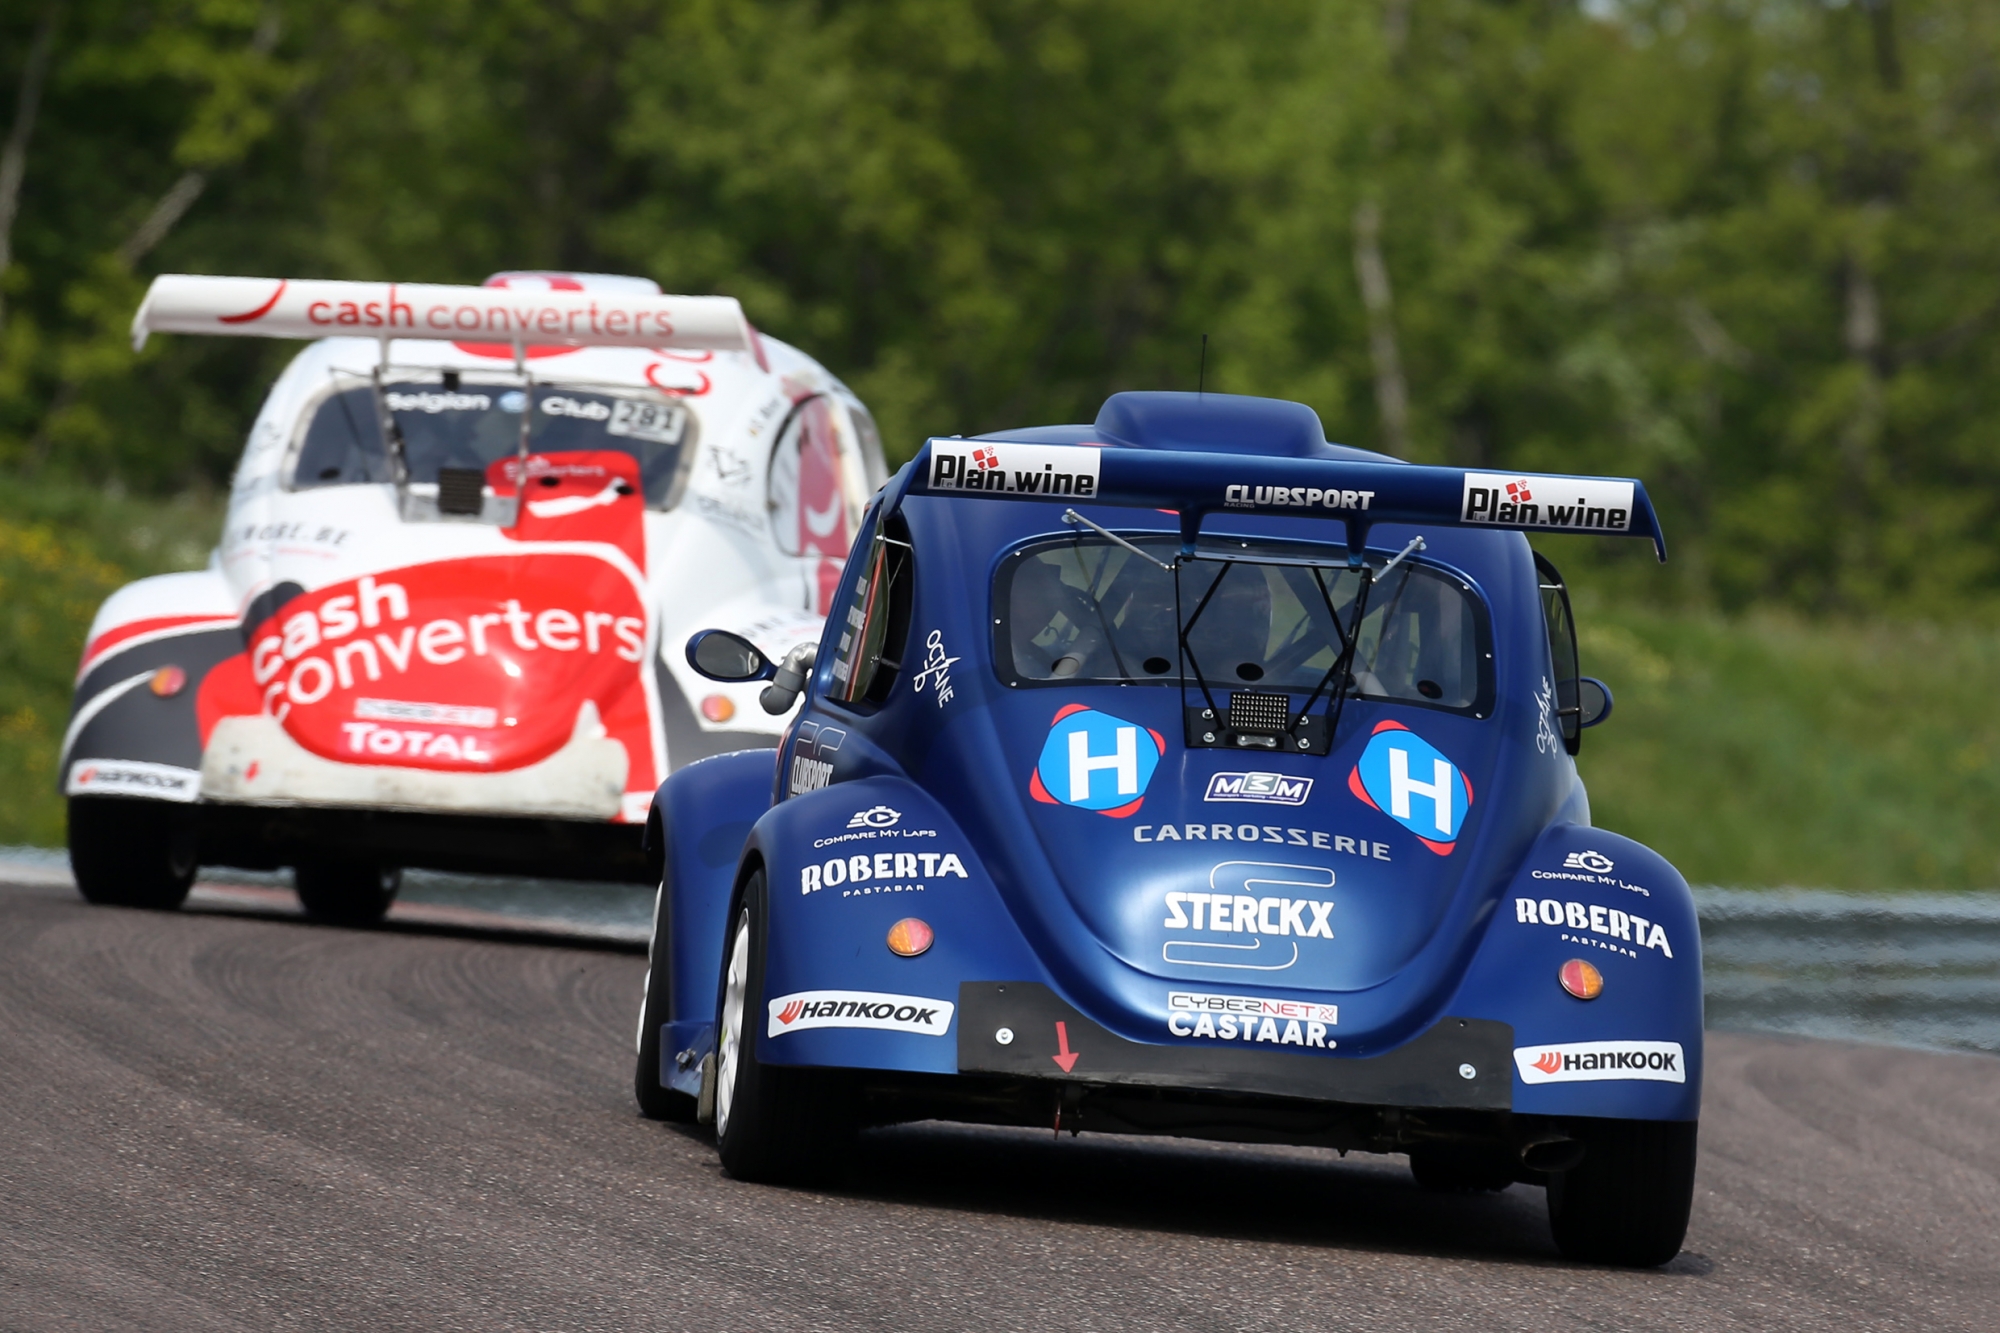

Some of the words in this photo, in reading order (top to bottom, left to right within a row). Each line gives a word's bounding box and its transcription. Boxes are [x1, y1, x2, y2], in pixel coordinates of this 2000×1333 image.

[308, 282, 414, 328] cash
[427, 300, 674, 338] converters
[540, 396, 611, 421] Club
[933, 455, 1094, 496] Plan.wine
[1225, 484, 1375, 511] CLUBSPORT
[1466, 488, 1627, 529] Plan.wine
[253, 577, 409, 684] cash
[265, 600, 644, 722] converters
[341, 722, 491, 763] TOTAL
[1068, 726, 1138, 803] H
[1388, 747, 1452, 836] H
[1133, 824, 1392, 862] CARROSSERIE
[801, 853, 969, 896] ROBERTA
[842, 884, 925, 898] PASTABAR
[1163, 891, 1335, 940] STERCKX
[1515, 898, 1674, 959] ROBERTA
[1561, 933, 1637, 959] PASTABAR
[1168, 1011, 1338, 1050] CASTAAR.
